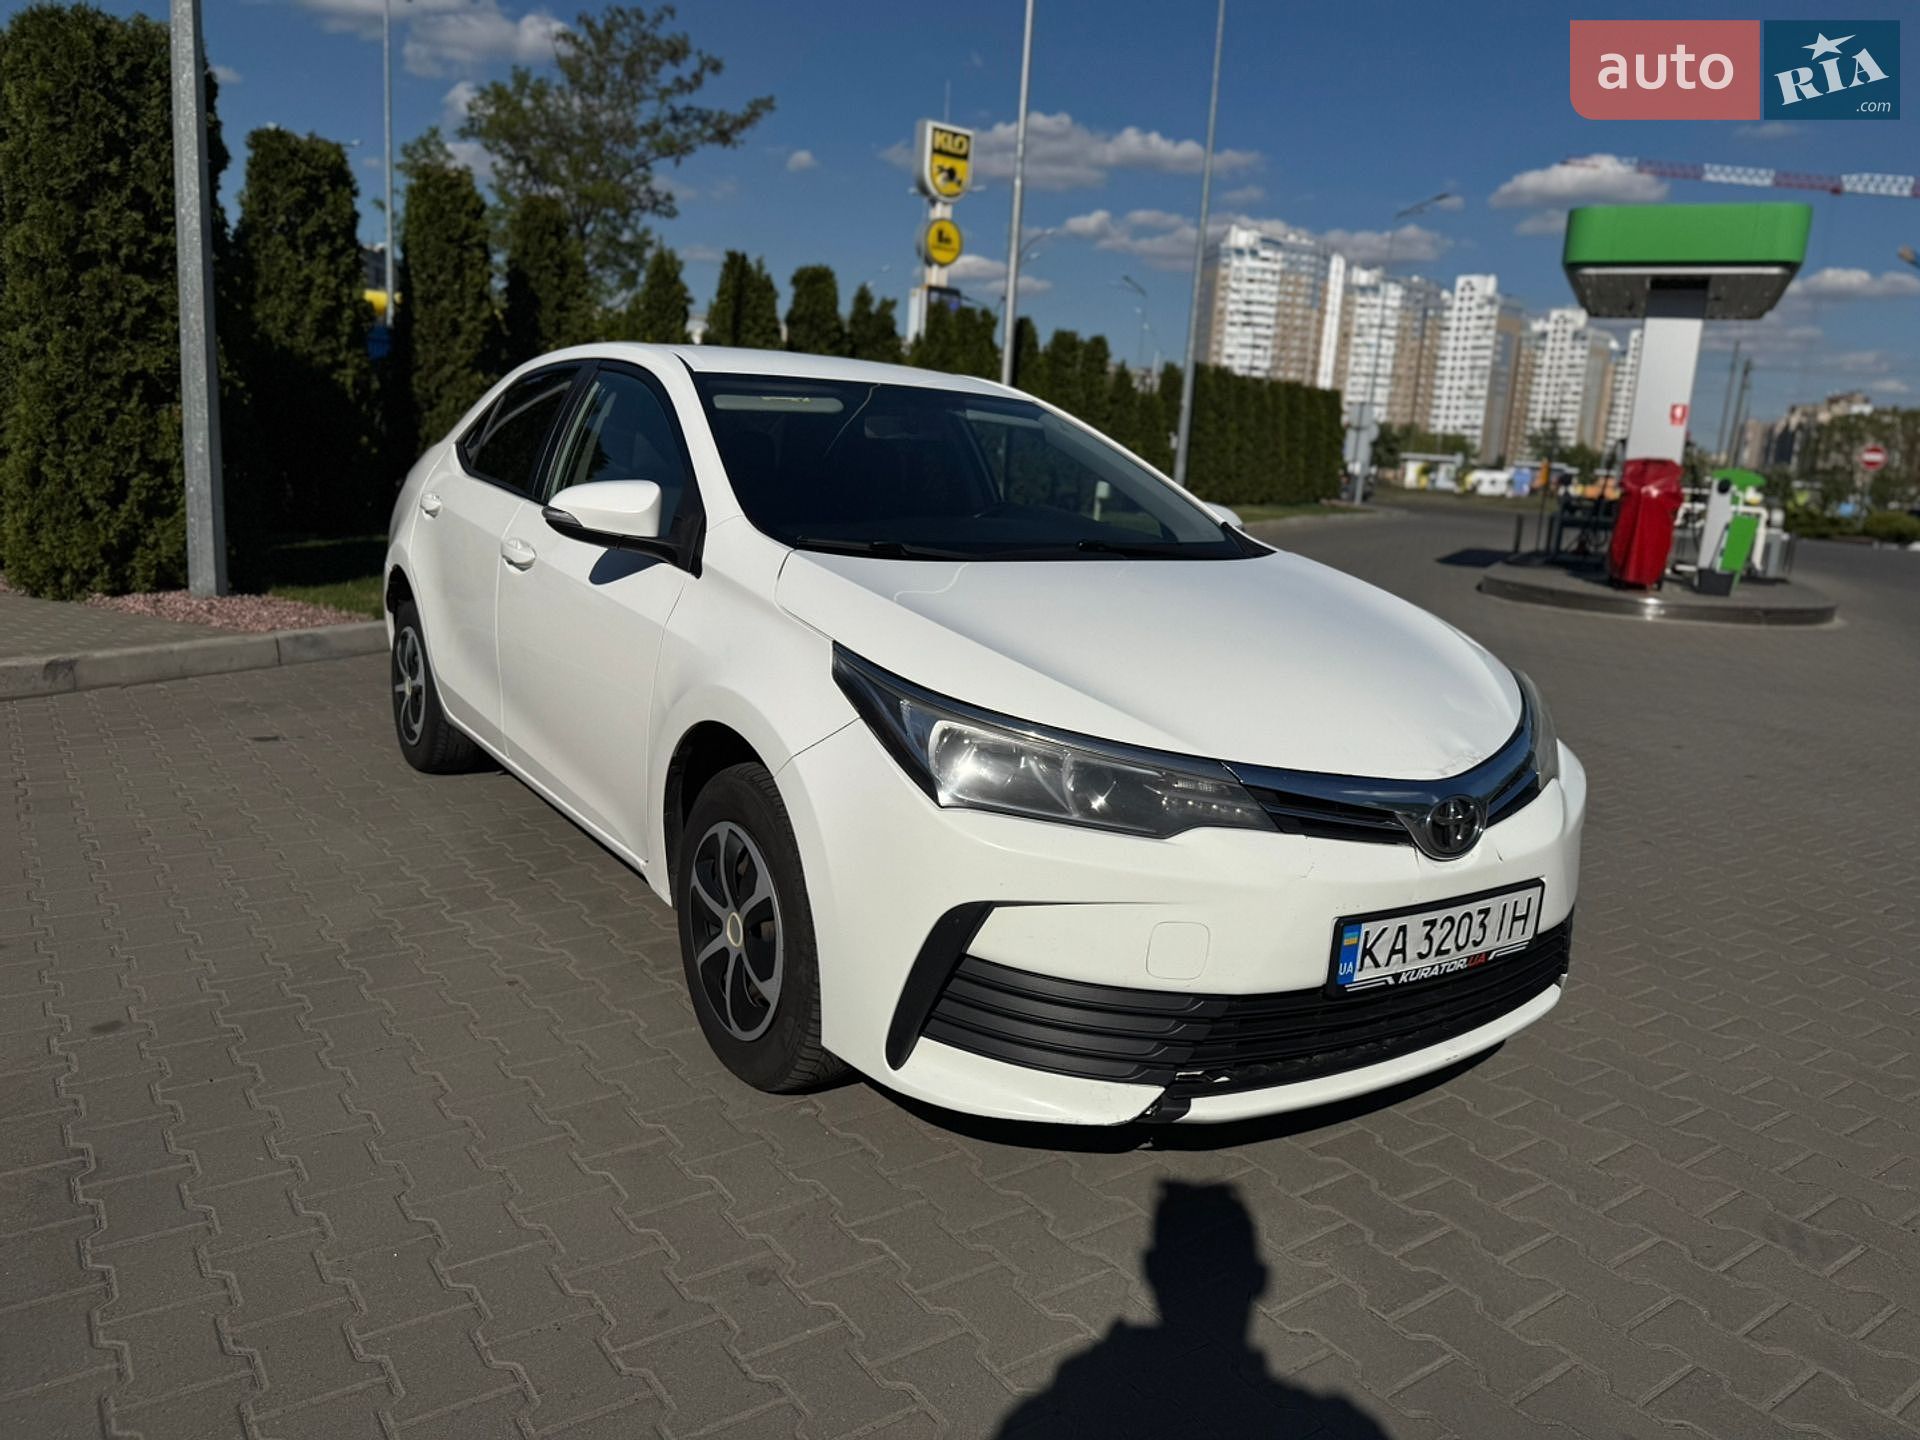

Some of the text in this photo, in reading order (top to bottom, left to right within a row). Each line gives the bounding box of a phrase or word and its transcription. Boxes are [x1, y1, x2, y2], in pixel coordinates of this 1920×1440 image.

[934, 130, 968, 154] KLO
[1358, 897, 1532, 971] KA 3203 IH
[1339, 961, 1353, 975] UA
